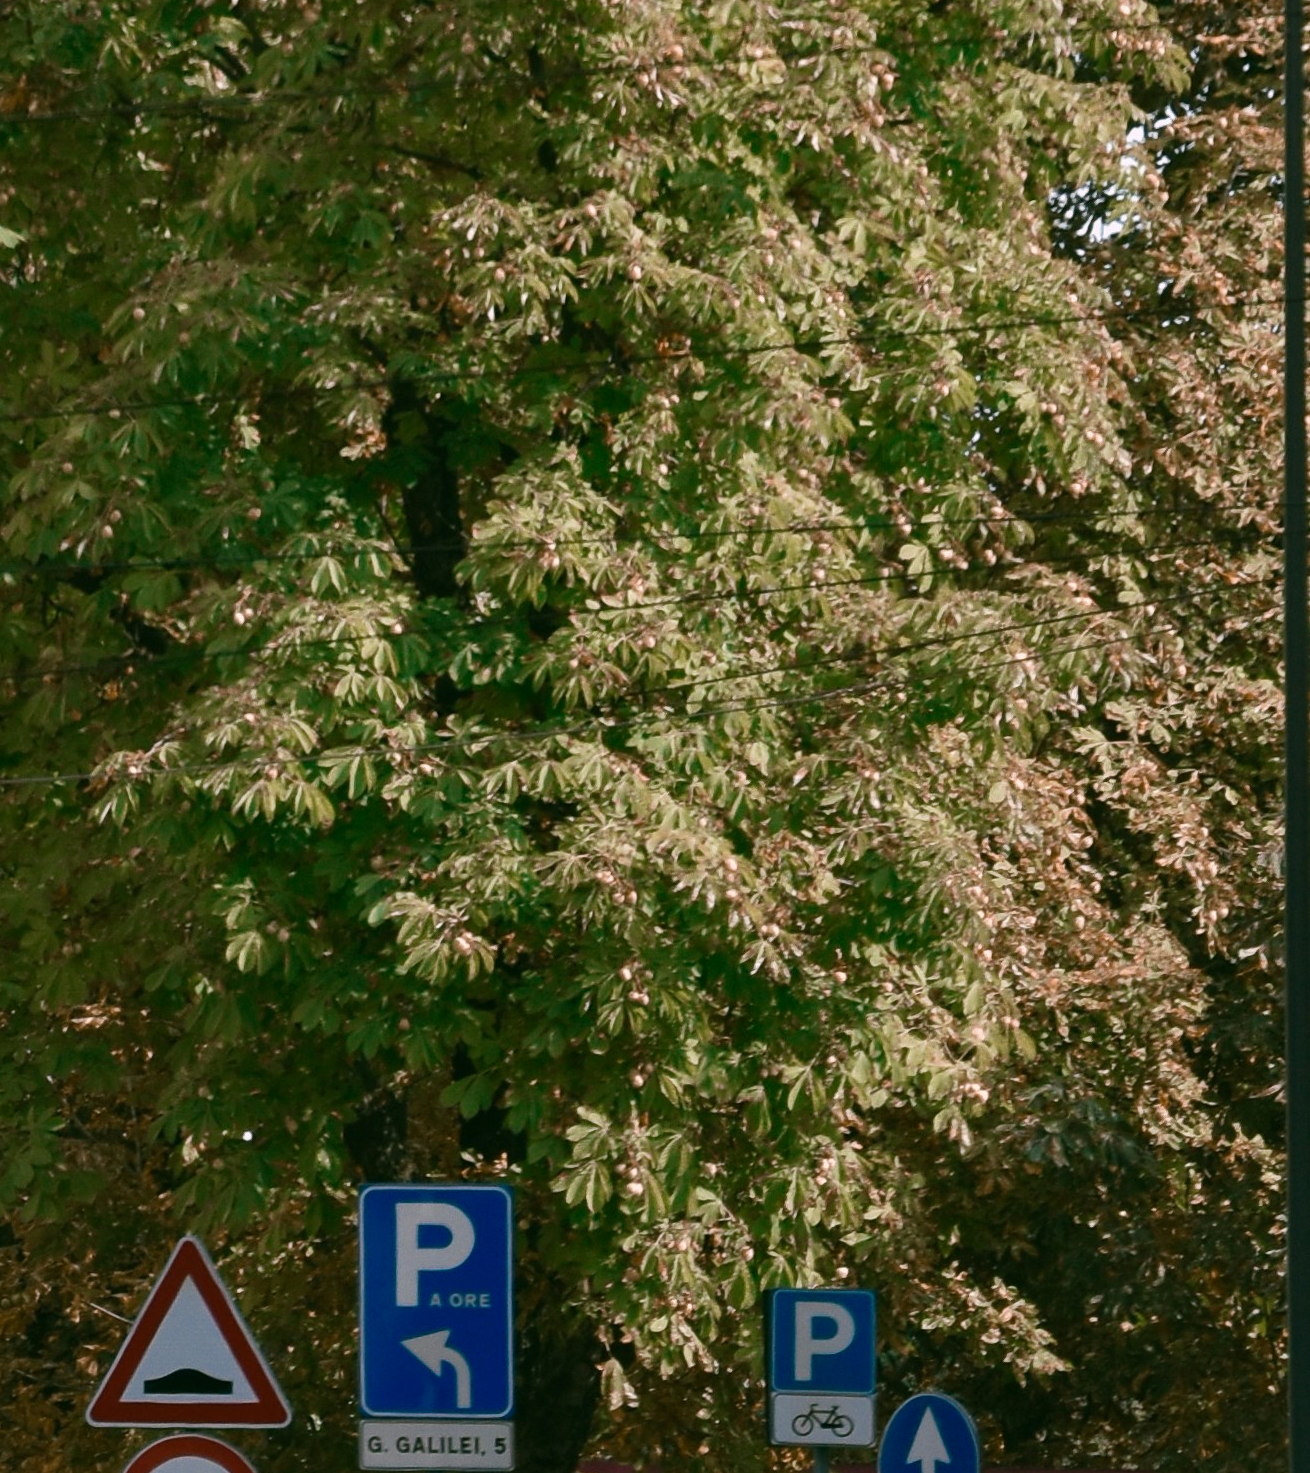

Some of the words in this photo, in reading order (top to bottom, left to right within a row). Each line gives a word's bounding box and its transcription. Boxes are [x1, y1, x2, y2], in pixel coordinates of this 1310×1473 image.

[395, 1202, 475, 1307] P
[430, 1293, 442, 1307] A
[449, 1293, 492, 1307] ORE
[794, 1301, 855, 1381] P
[367, 1436, 389, 1453] G.
[396, 1436, 486, 1457] GALILEI,
[494, 1437, 507, 1454] 5
